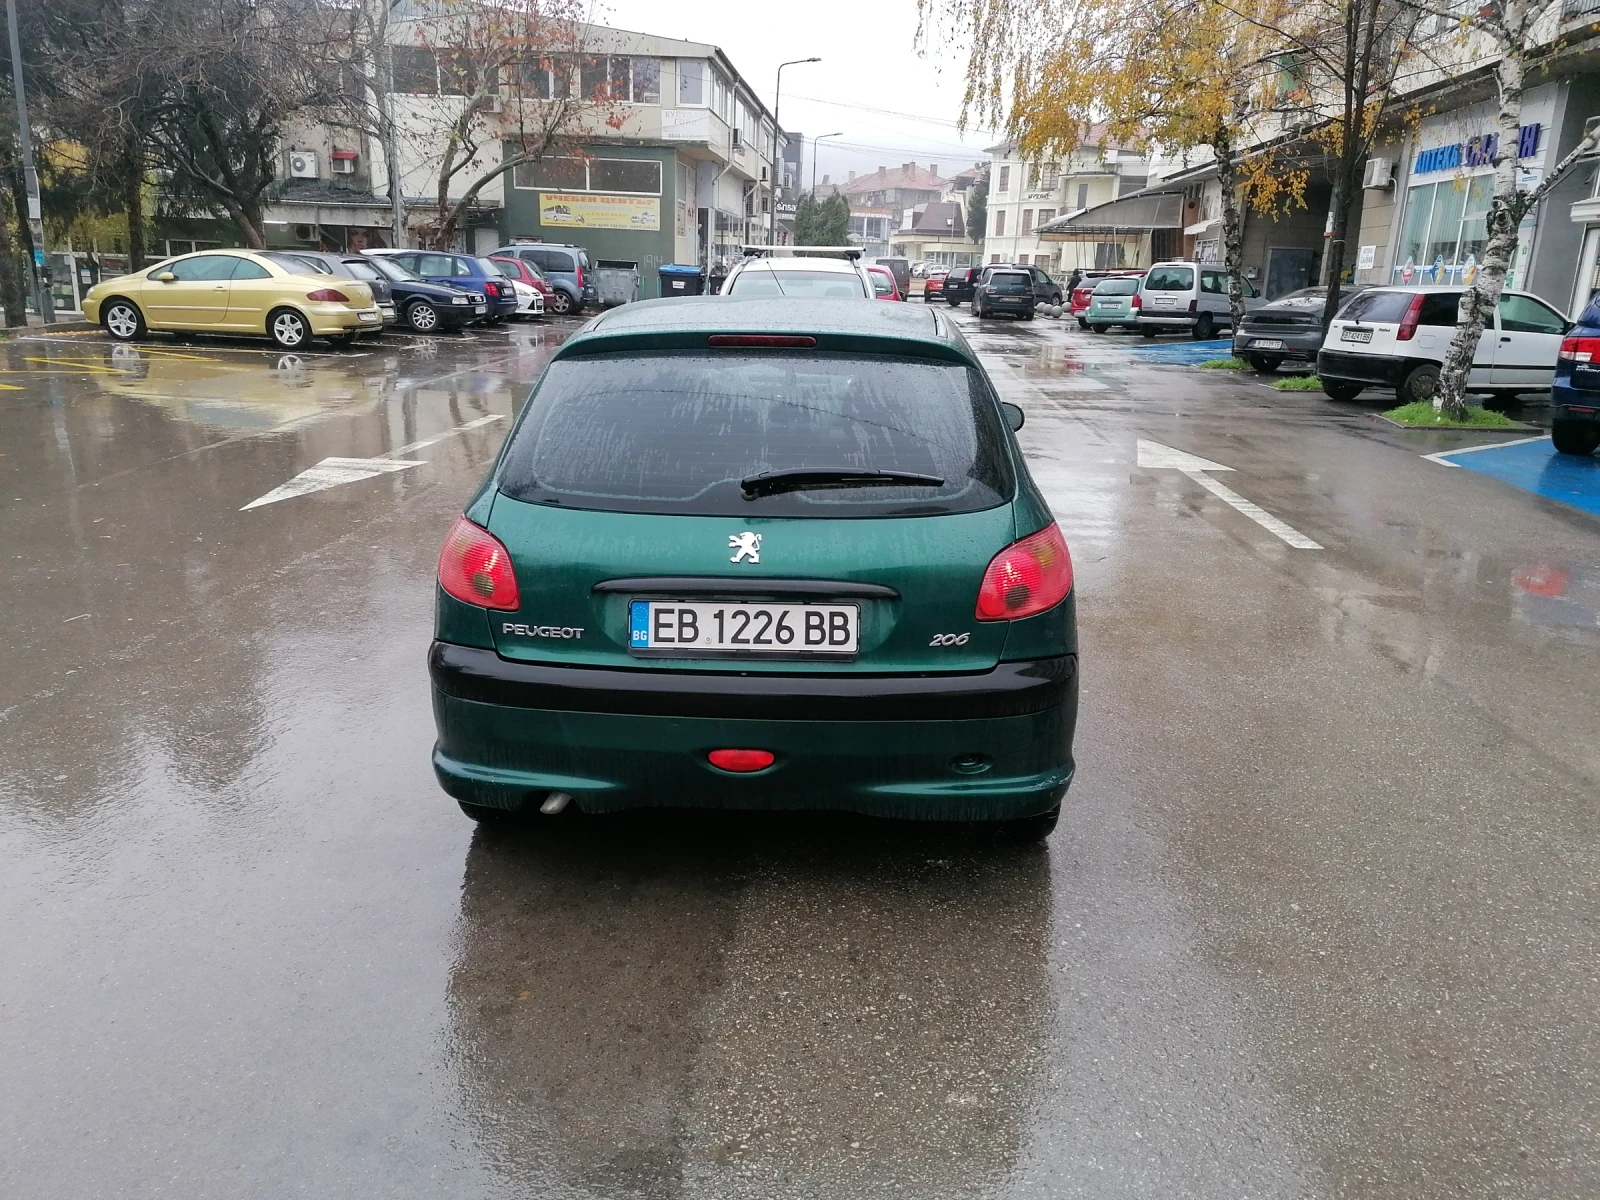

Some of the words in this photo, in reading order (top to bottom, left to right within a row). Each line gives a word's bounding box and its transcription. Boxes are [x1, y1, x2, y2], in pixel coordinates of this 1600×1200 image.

[1414, 143, 1462, 174] АПТЕКА
[502, 622, 585, 639] PEUGEOT
[632, 629, 648, 641] BG
[653, 608, 699, 643] EB
[713, 609, 795, 645] 1226
[804, 611, 851, 646] BB
[929, 632, 971, 647] 206
